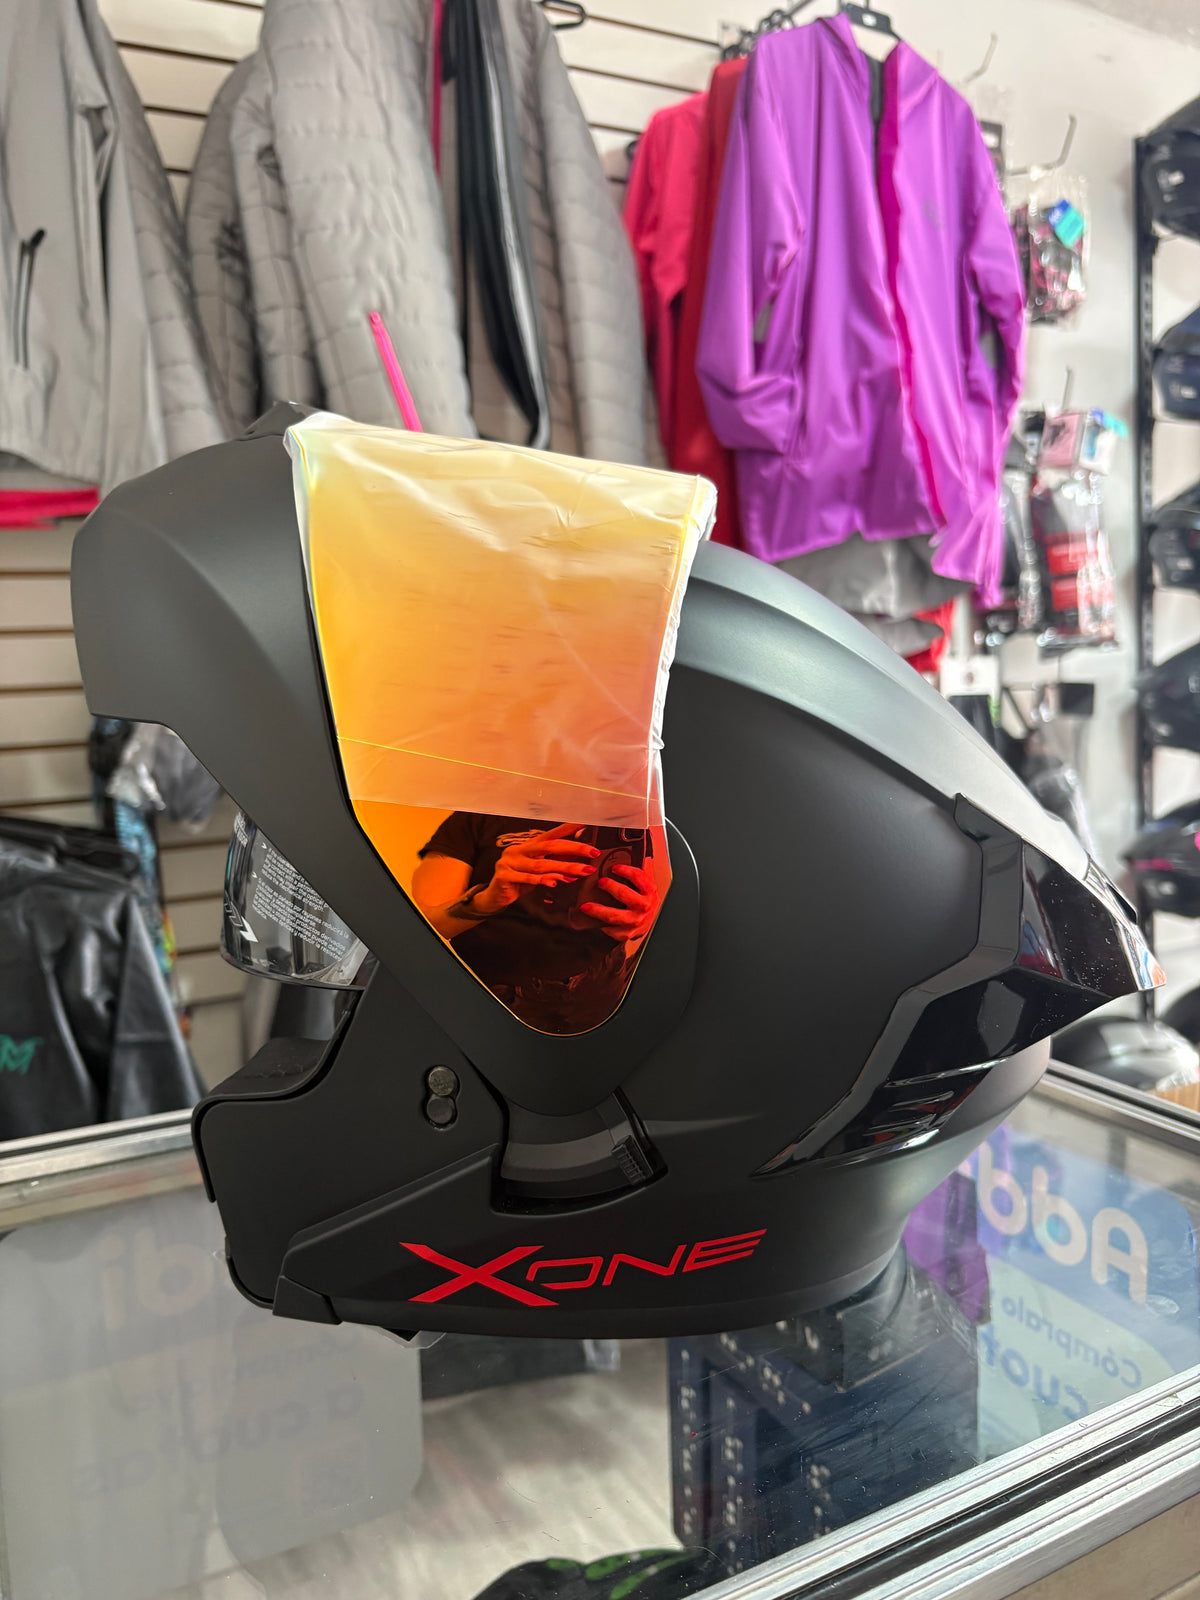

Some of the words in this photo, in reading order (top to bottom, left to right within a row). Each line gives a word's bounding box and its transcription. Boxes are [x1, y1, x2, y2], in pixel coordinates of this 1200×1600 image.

[306, 893, 324, 906] optical
[292, 904, 301, 912] por
[301, 909, 322, 924] rayones
[295, 918, 320, 935] productos
[297, 931, 315, 945] reducir
[311, 933, 327, 946] puede
